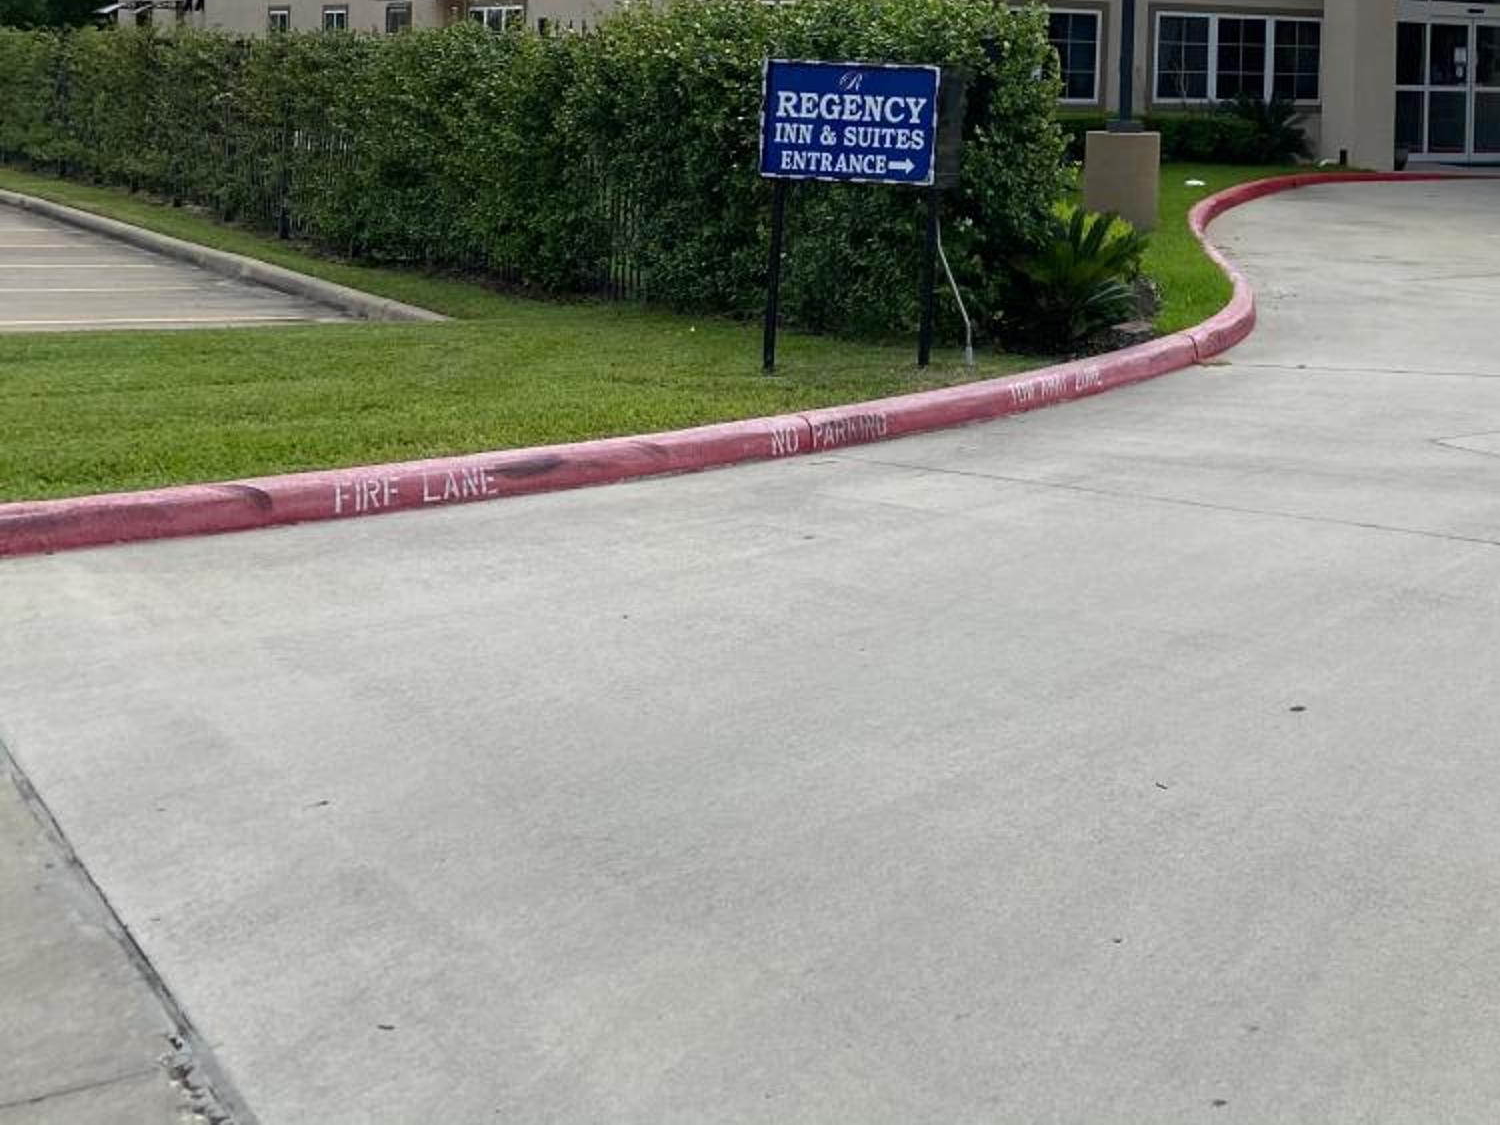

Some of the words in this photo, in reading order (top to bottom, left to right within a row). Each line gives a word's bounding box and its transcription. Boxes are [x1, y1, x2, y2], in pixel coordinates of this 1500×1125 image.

[775, 91, 928, 124] REGENCY
[774, 122, 814, 145] INN
[820, 126, 837, 146] &
[843, 126, 926, 151] SUITES
[780, 150, 888, 174] ENTRANCE
[770, 426, 800, 456] NO
[422, 465, 498, 503] LANE
